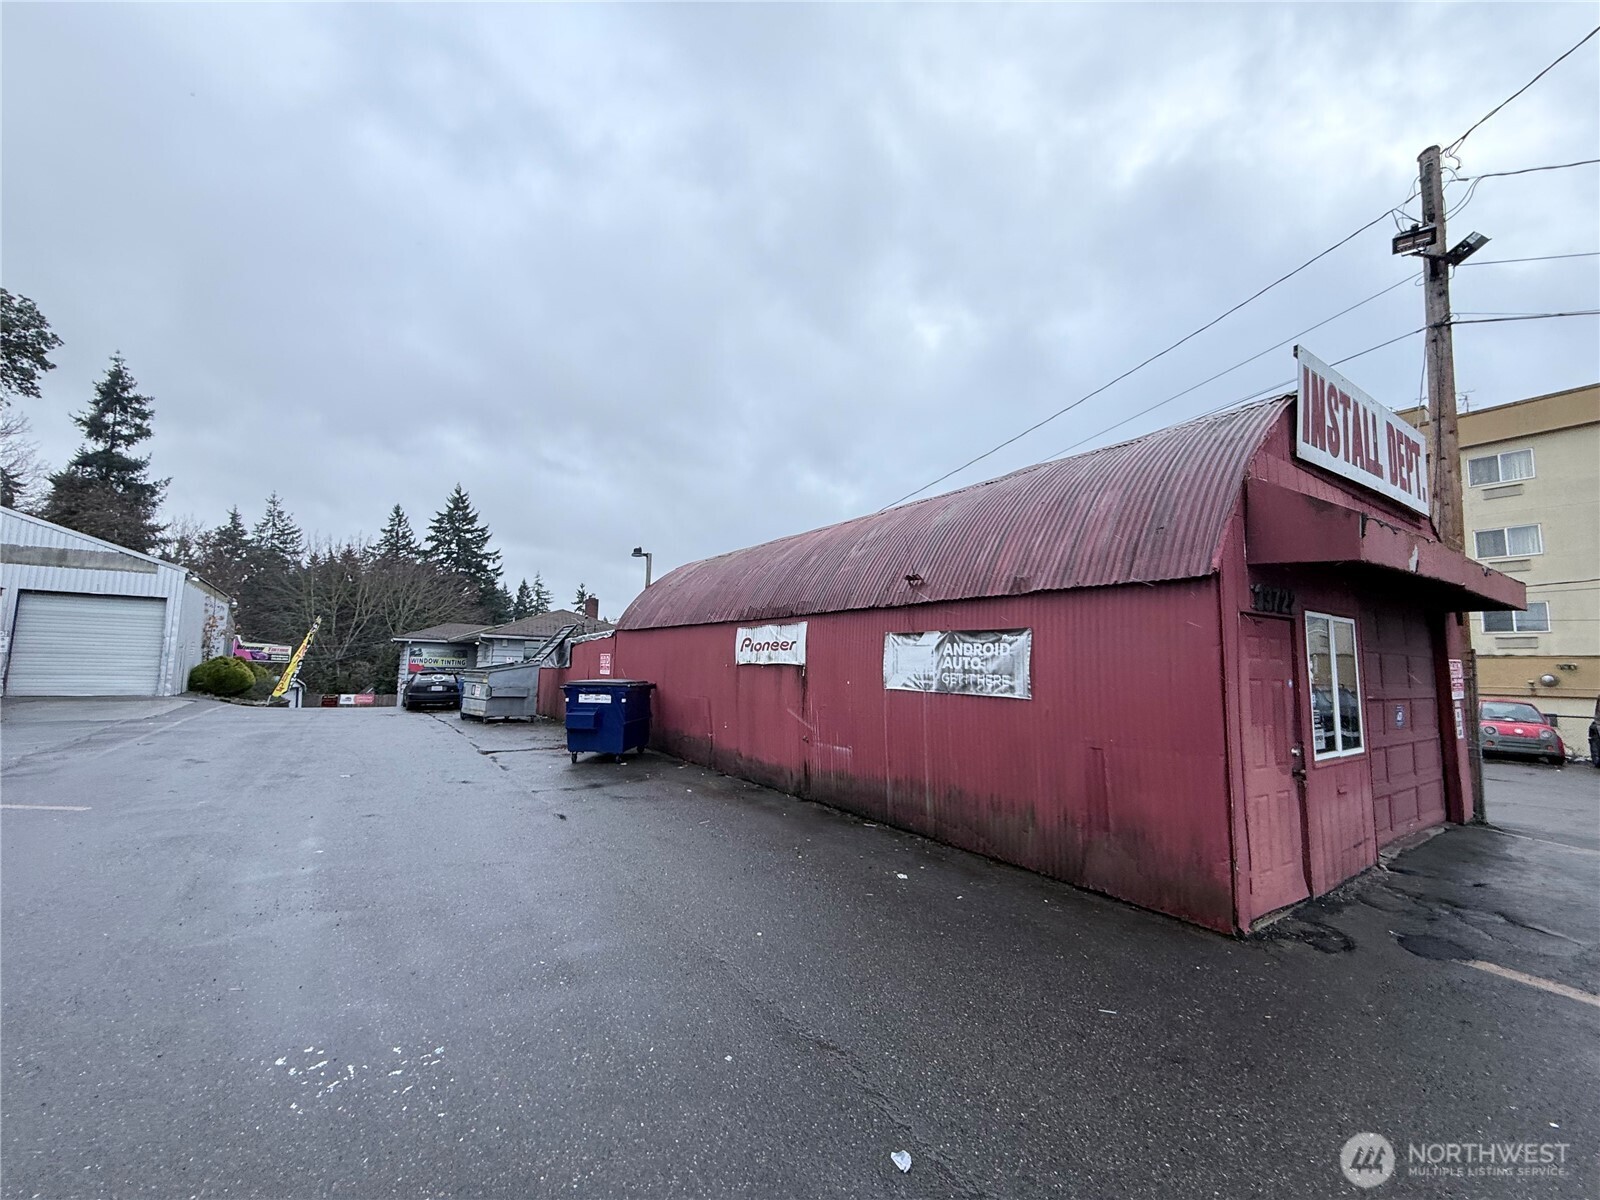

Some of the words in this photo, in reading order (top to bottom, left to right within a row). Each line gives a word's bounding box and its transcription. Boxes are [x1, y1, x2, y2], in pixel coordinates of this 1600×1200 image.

[1302, 364, 1384, 480] INSTALL
[1386, 420, 1427, 504] DEPT.
[740, 637, 797, 652] Pioneer
[943, 642, 1011, 656] ANDROID
[942, 656, 982, 669] AUTO
[941, 672, 964, 687] GET
[977, 674, 1011, 687] HERE
